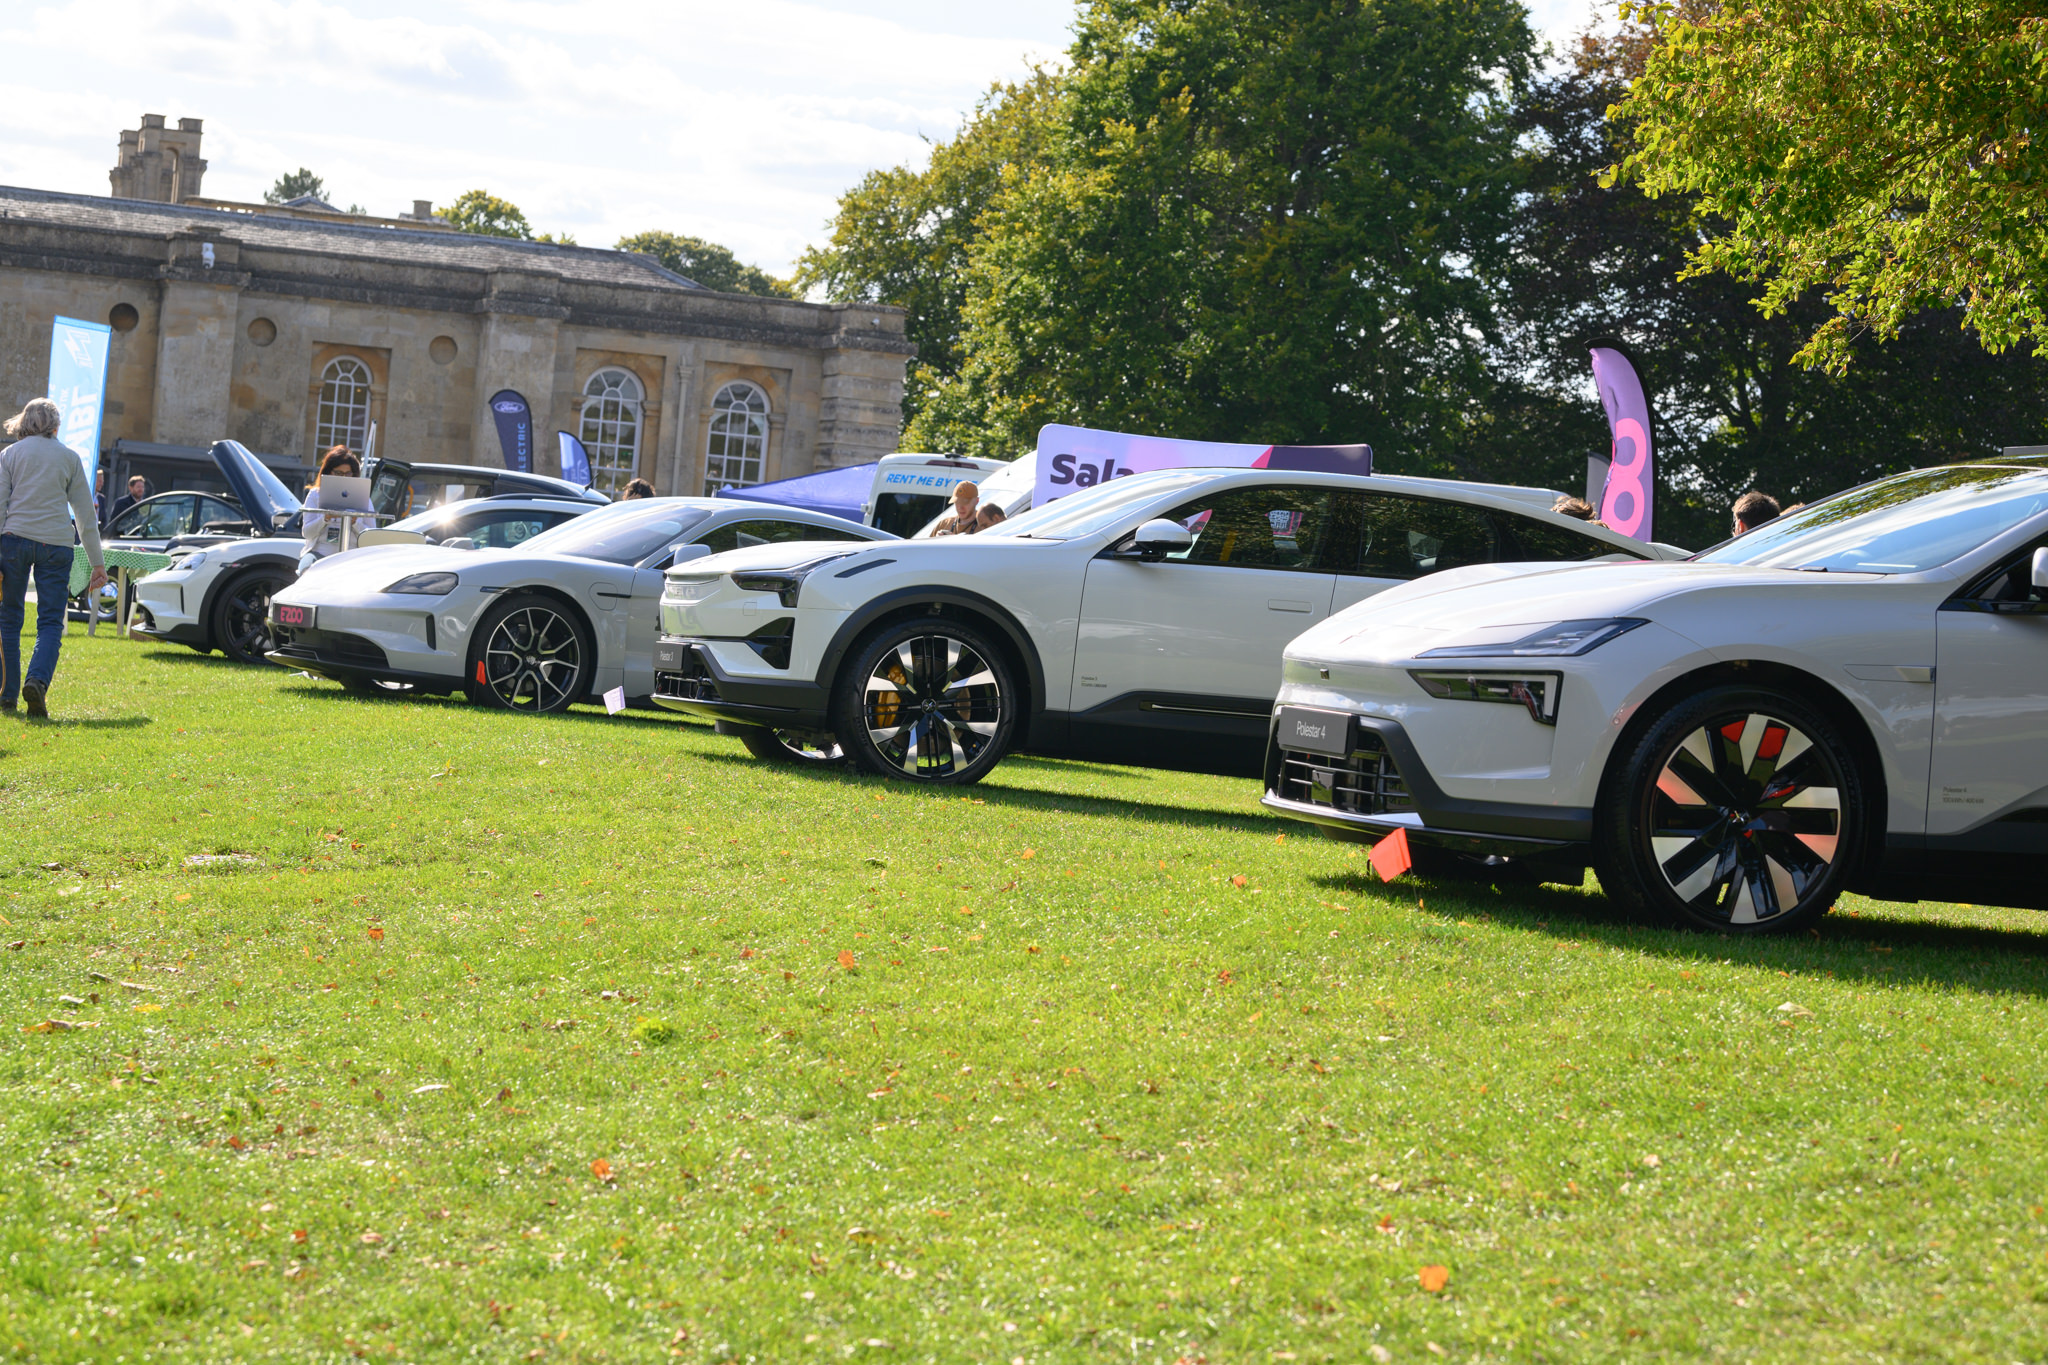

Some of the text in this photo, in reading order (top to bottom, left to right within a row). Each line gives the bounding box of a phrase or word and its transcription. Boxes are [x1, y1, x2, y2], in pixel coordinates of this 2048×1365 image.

[886, 473, 917, 485] RENT
[916, 475, 935, 487] ME
[934, 476, 953, 488] BY
[1296, 720, 1326, 740] Polestar 4
